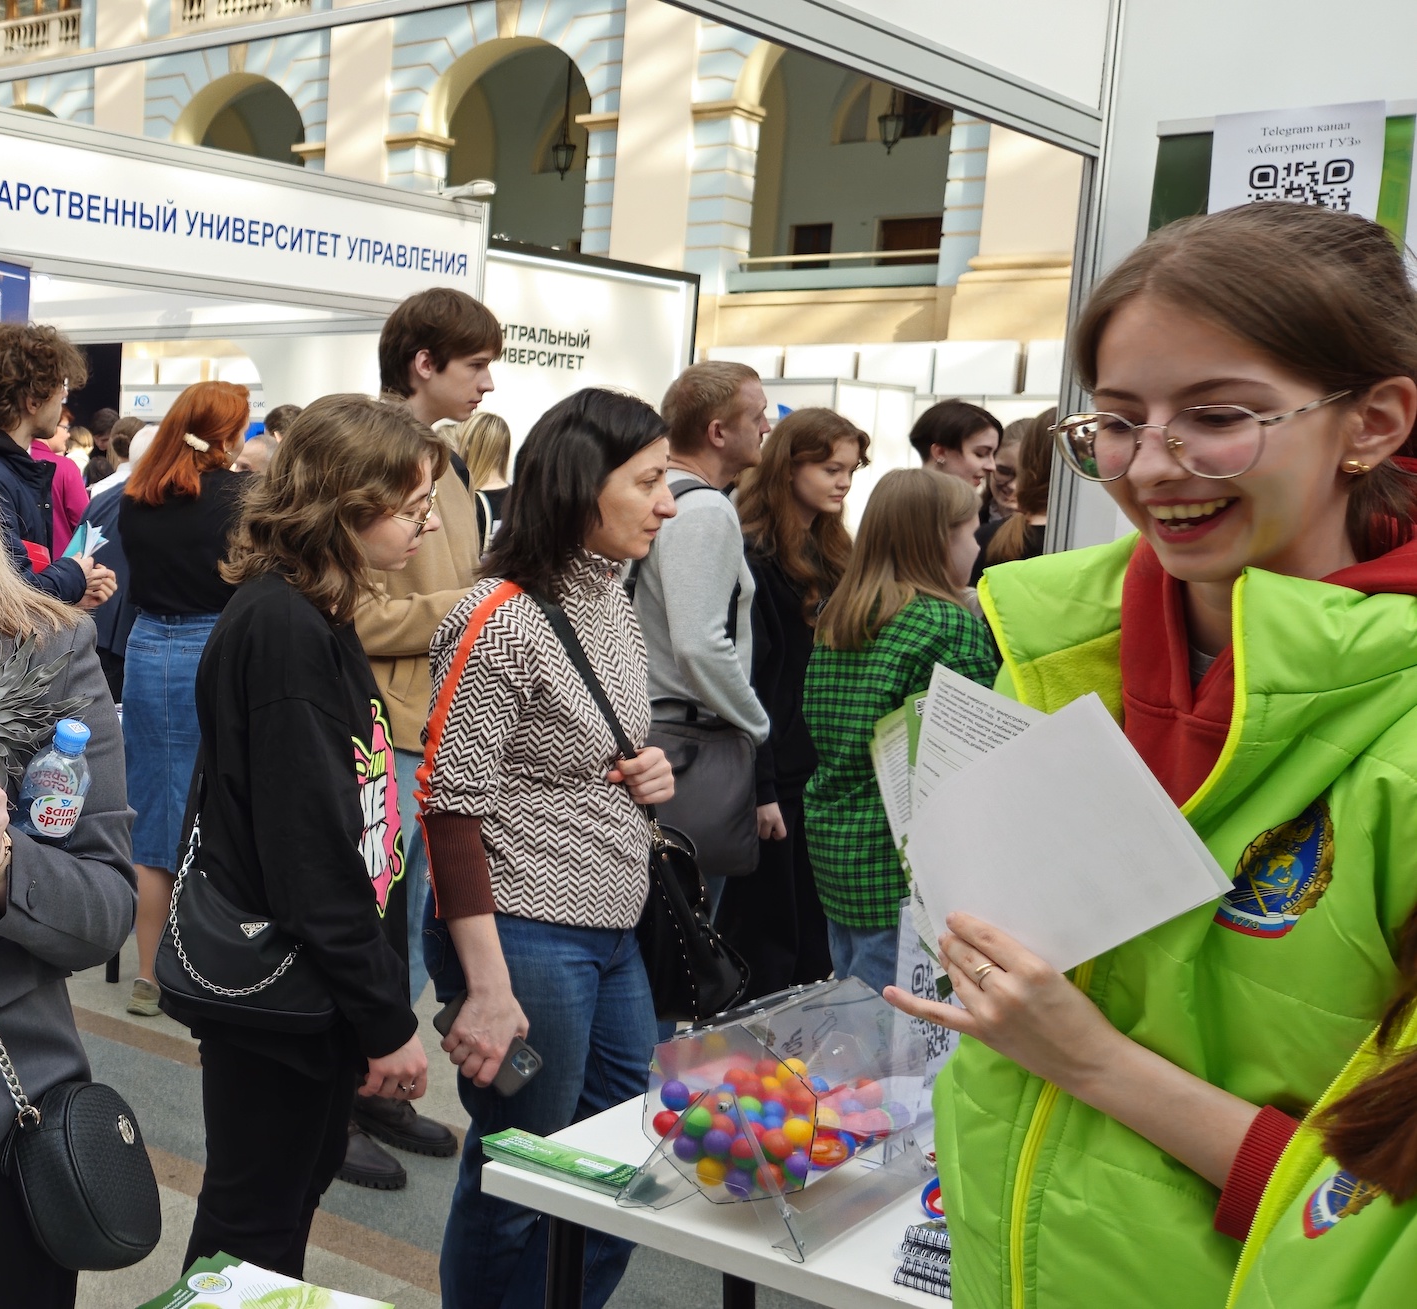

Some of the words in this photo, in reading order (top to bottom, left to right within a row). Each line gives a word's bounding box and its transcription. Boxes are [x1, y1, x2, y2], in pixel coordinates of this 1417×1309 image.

[1260, 126, 1313, 138] Telegram
[1317, 122, 1351, 132] канал
[1247, 141, 1326, 154] «Абитуриент
[1329, 136, 1362, 148] ГУЗ»
[185, 209, 341, 258] УНИВЕРСИТЕТ
[347, 236, 468, 277] УПРАВЛЕНИЯ
[499, 323, 591, 349] НТРАЛЬНЫЙ
[500, 347, 584, 370] ИВЕРСИТЕТ
[45, 806, 78, 817] saint
[1232, 914, 1260, 931] 1779
